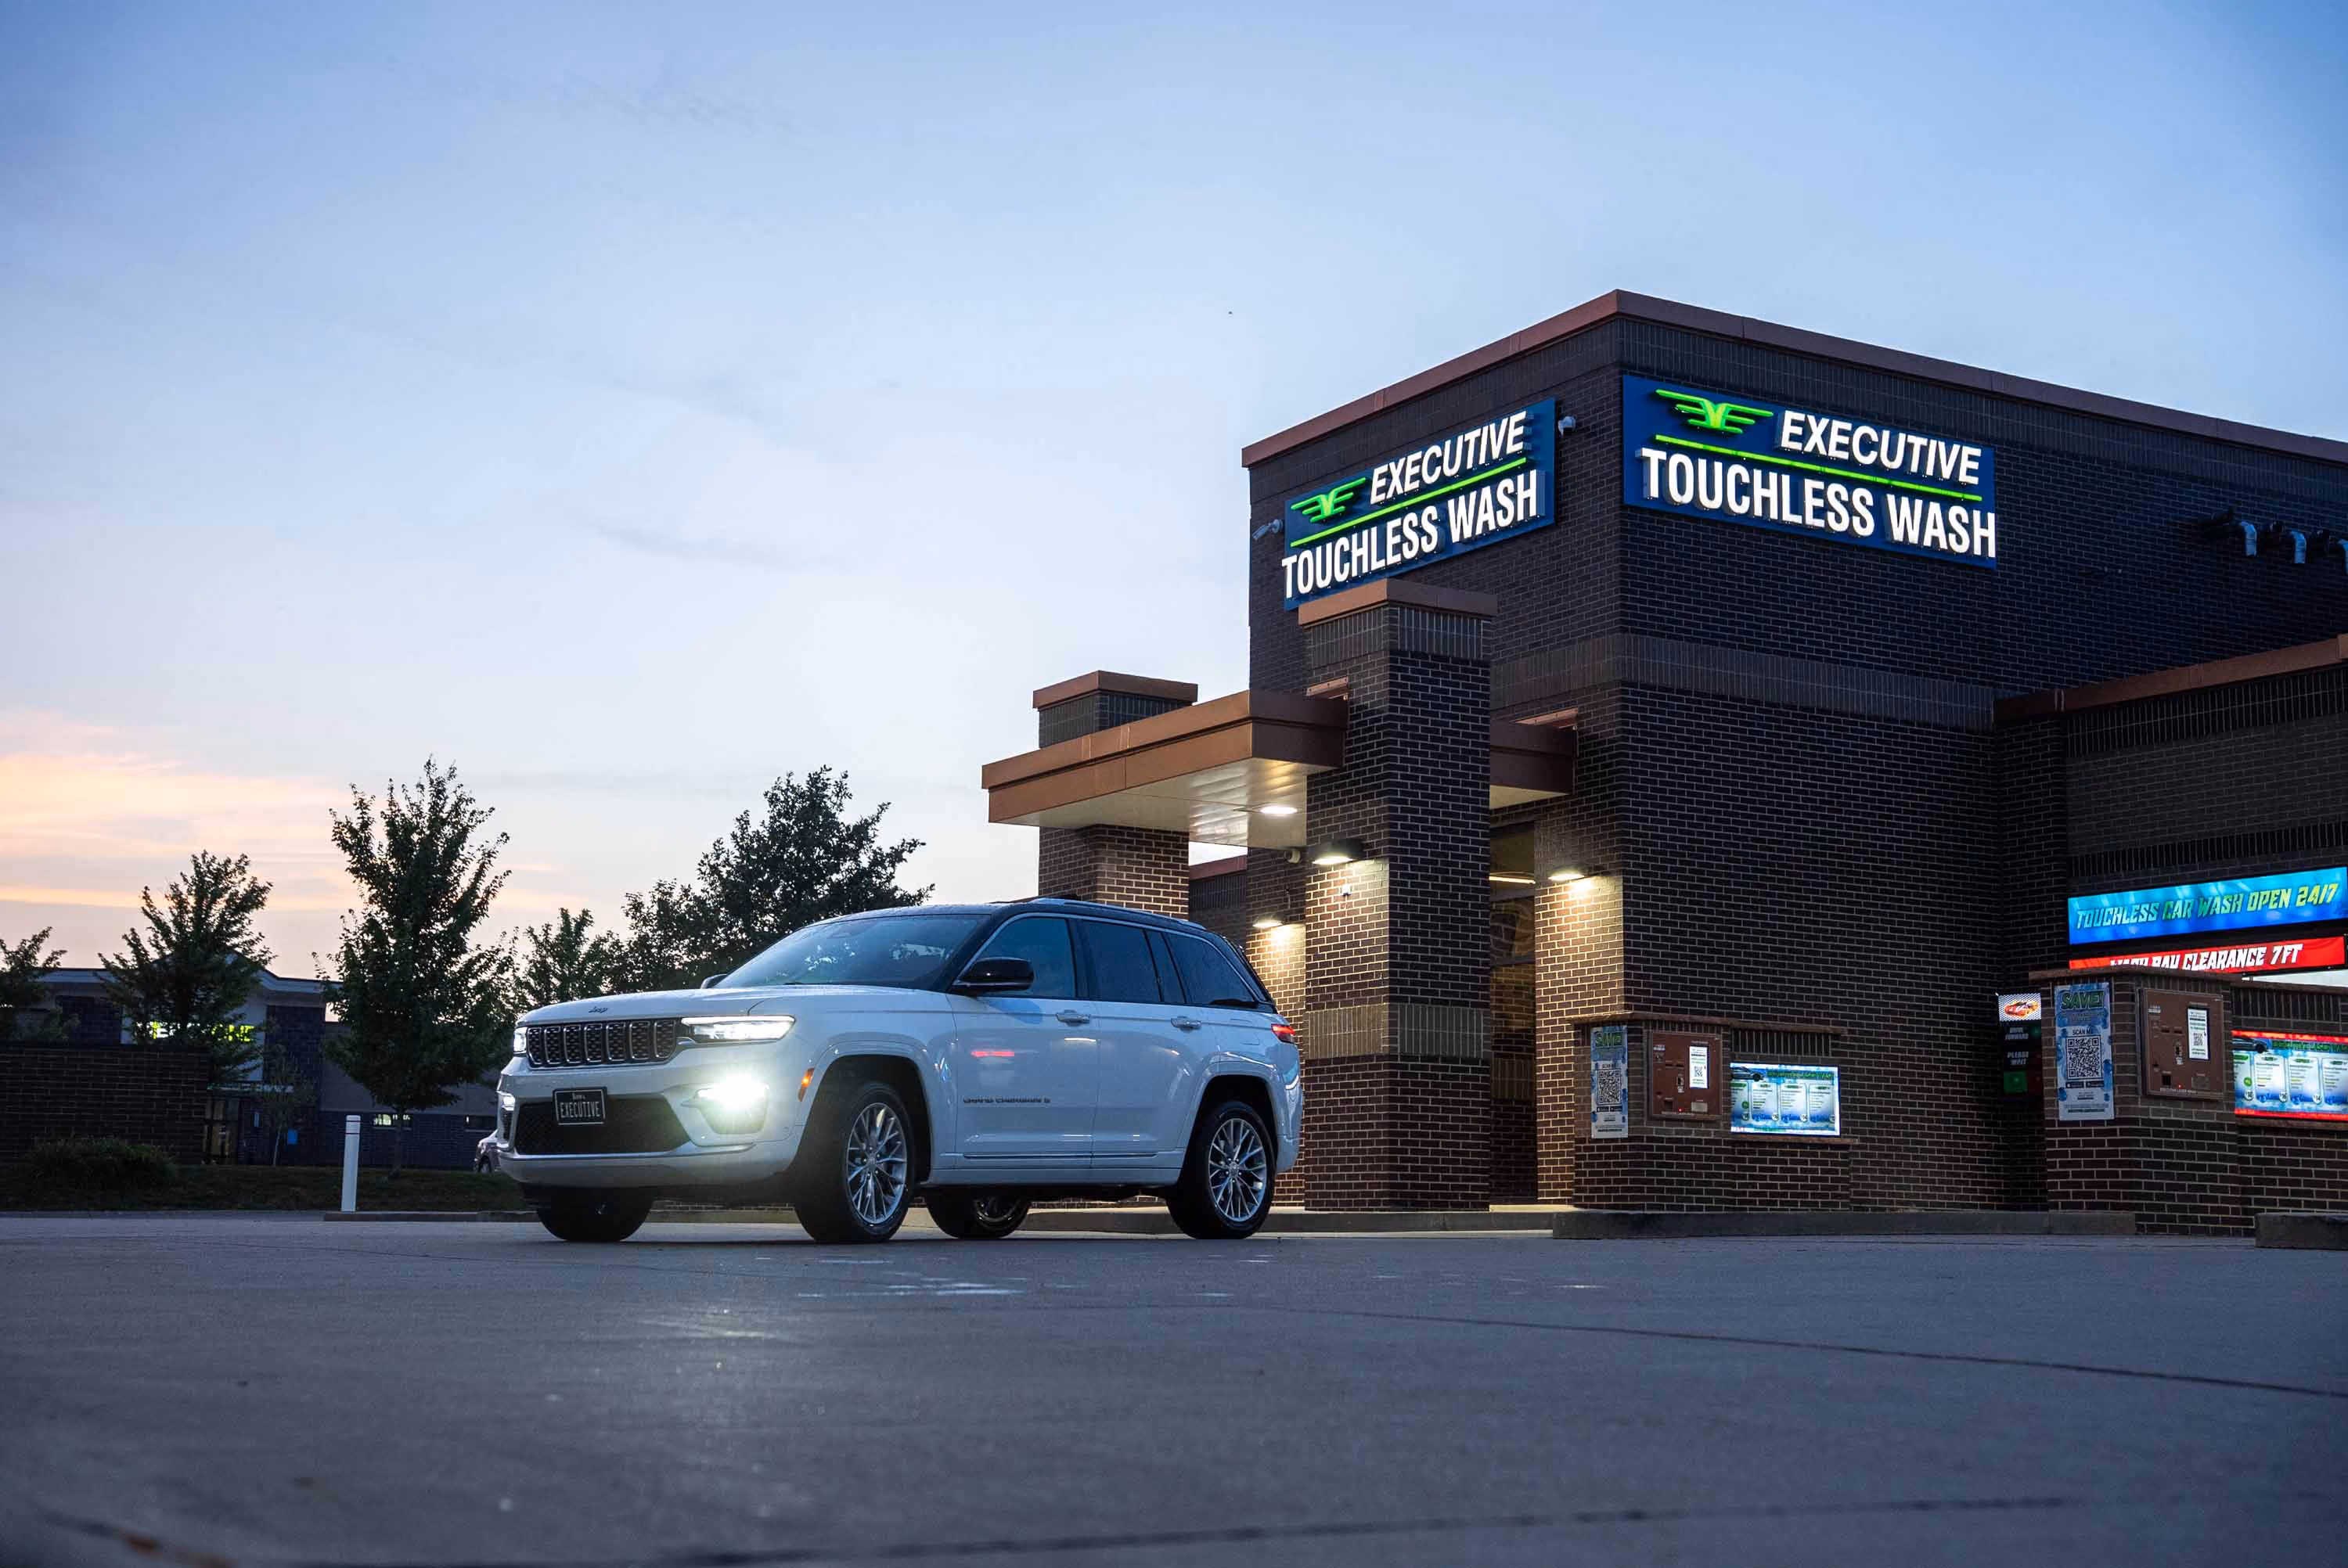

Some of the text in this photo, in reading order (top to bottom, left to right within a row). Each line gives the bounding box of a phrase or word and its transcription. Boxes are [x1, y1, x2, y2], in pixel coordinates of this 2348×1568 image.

[1370, 410, 1527, 505] EXECUTIVE
[1781, 409, 1982, 485] EXECUTIVE
[1641, 447, 1996, 558] TOUCHLESS WASH
[1281, 469, 1537, 599] TOUCHLESS WASH
[2076, 883, 2339, 930] TOUCHLESS CAR WASH OPEN 24/7
[2181, 946, 2267, 972] CLEARANCE
[2270, 943, 2304, 966] 7FT
[2061, 991, 2105, 1011] SAVE!
[560, 1101, 601, 1119] EXECUTIVE
